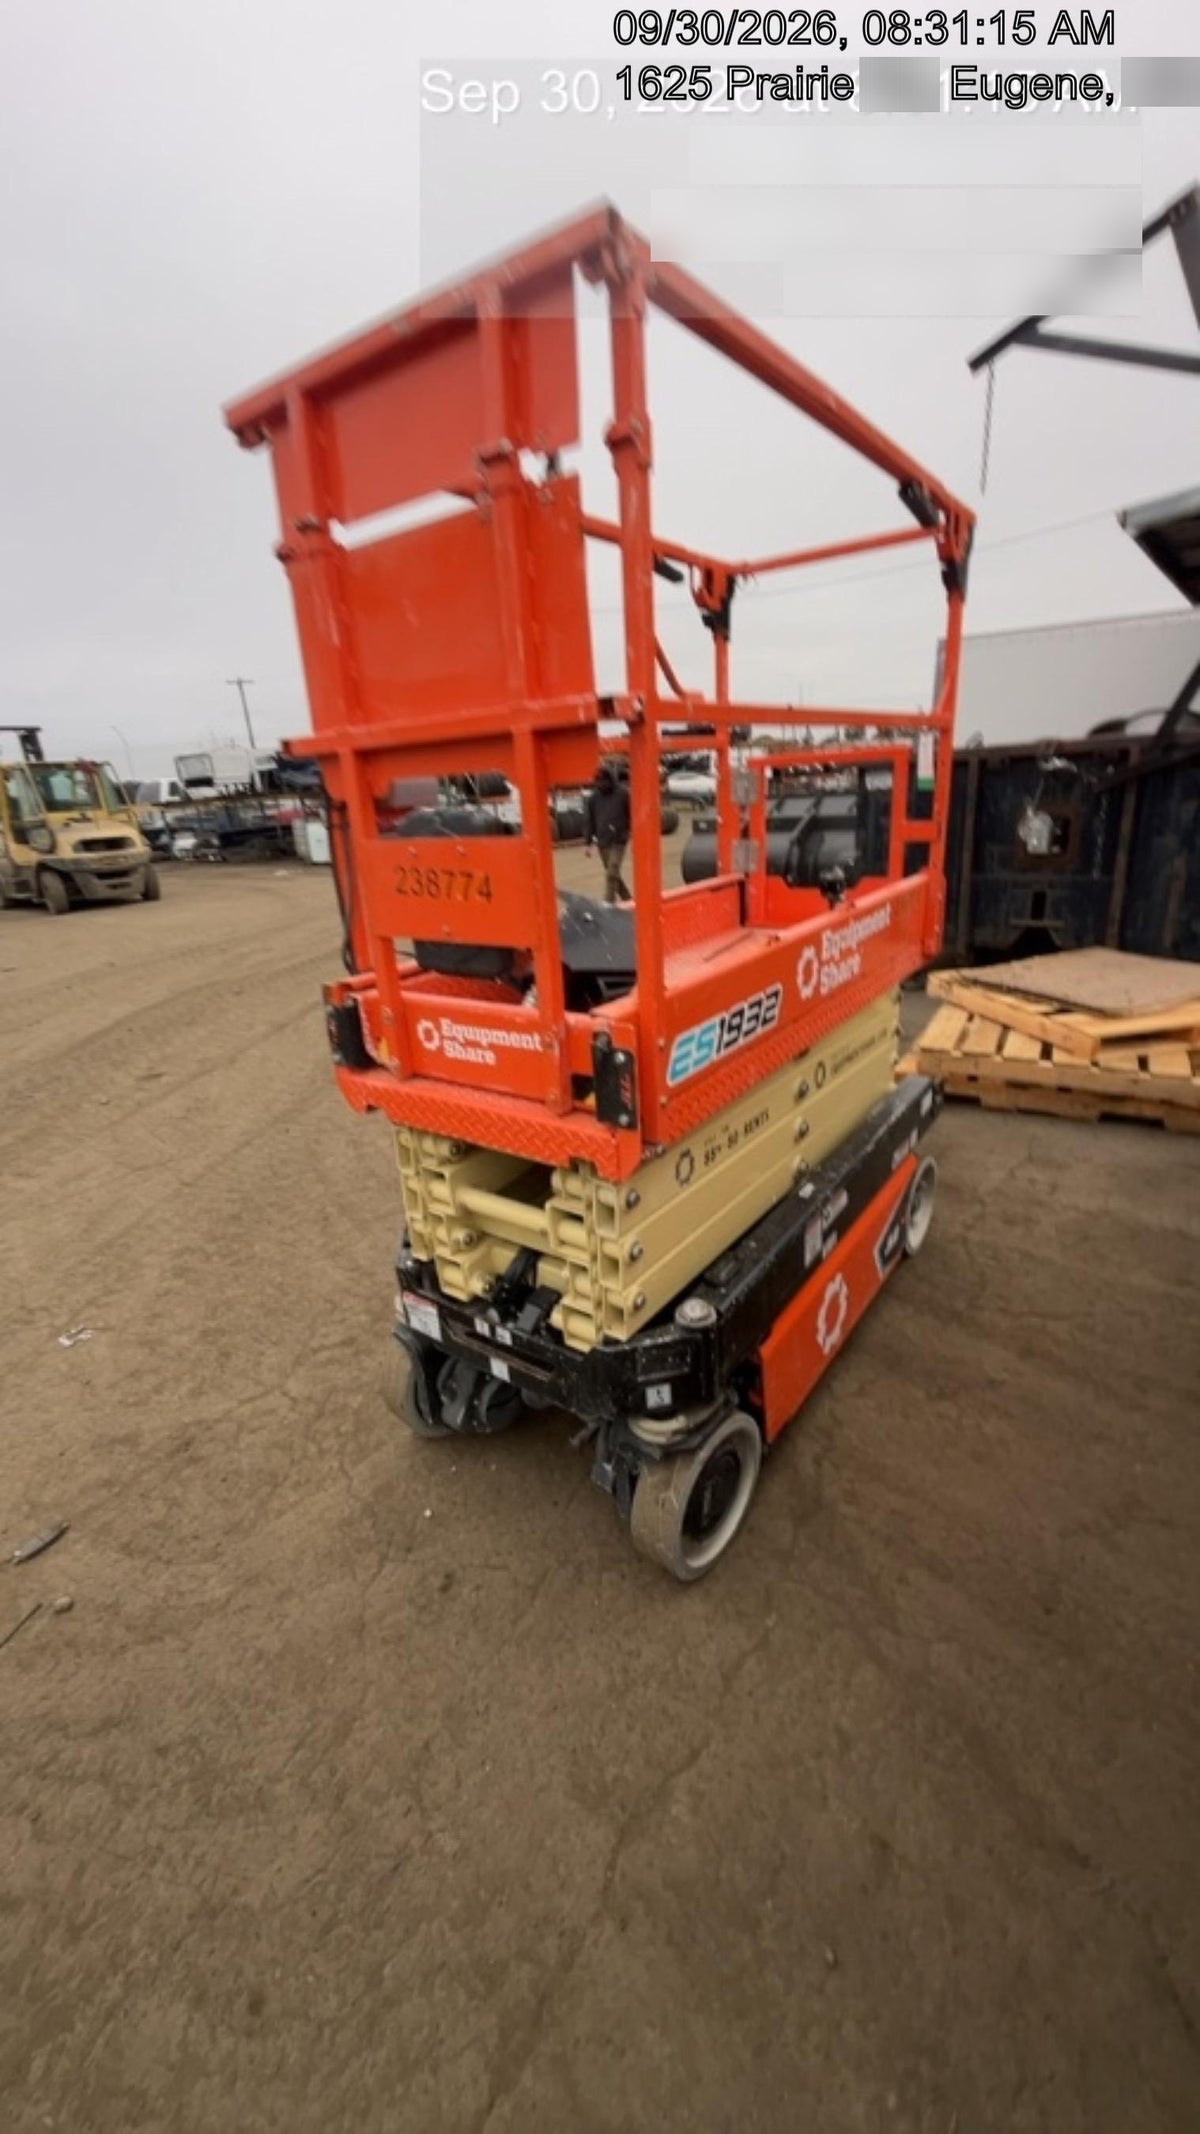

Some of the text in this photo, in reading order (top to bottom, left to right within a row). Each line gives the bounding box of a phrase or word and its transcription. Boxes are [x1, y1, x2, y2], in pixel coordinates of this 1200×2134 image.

[395, 865, 493, 903] 238774
[821, 902, 891, 961] Equipment
[820, 952, 861, 996] Share
[439, 1017, 543, 1051] Equipment
[443, 1040, 497, 1066] Share
[669, 987, 781, 1082] ES1932
